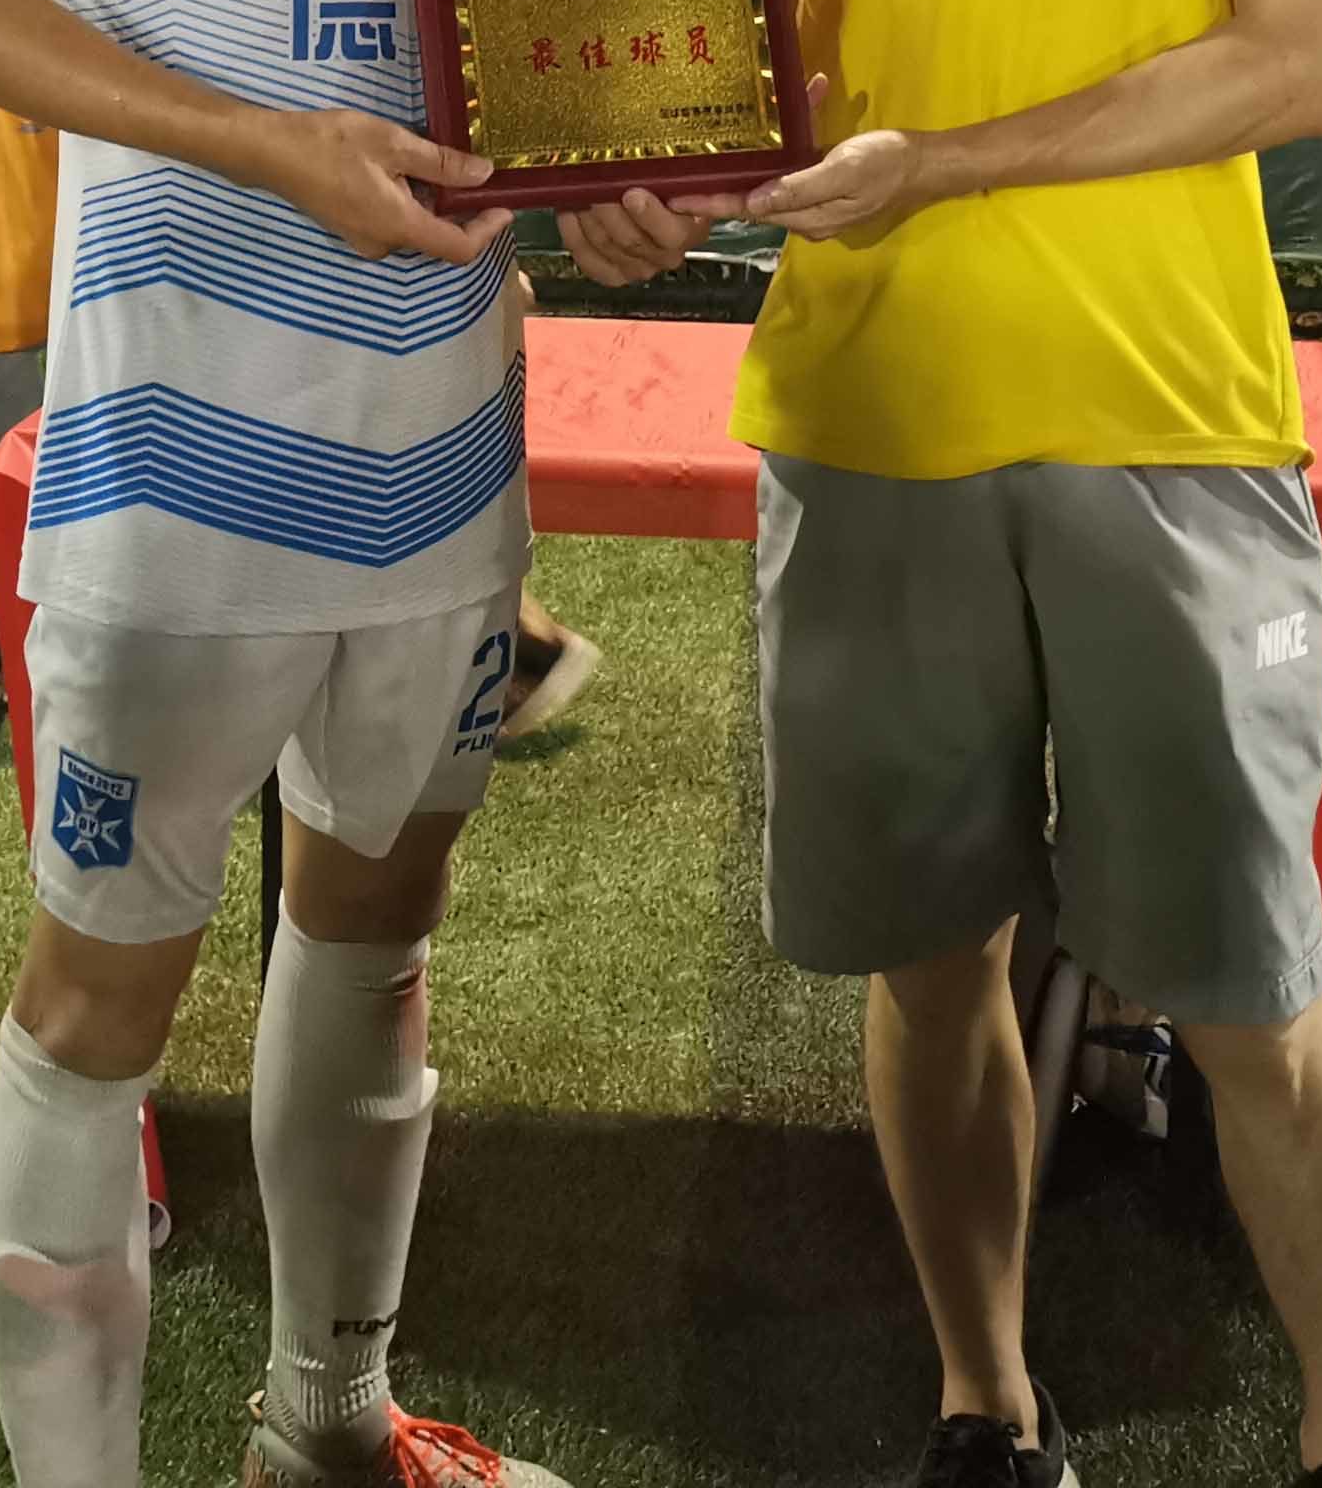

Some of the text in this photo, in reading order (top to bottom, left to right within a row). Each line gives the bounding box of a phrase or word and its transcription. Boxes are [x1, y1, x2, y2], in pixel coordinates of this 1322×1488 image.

[524, 24, 715, 75] 最佳球员
[1255, 610, 1309, 671] NIKE
